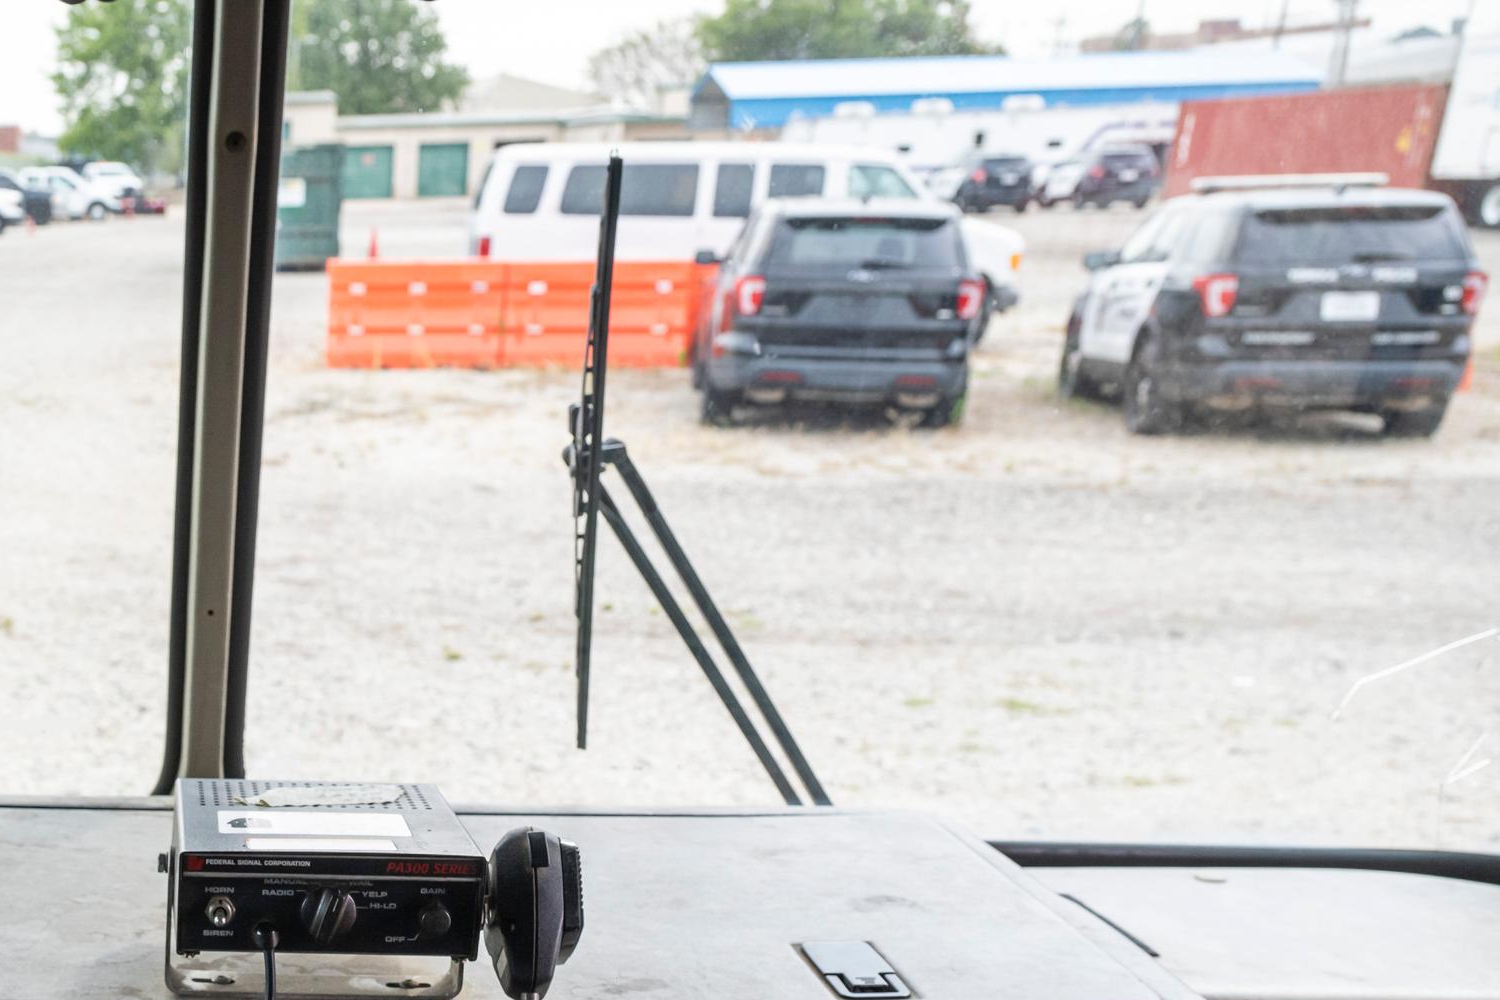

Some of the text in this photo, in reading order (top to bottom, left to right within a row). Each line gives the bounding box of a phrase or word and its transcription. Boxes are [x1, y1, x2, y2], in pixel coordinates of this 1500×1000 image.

[205, 858, 311, 868] FEDERAL SIGNAL CORPORATION
[386, 861, 477, 875] PA300 SERIES
[204, 886, 235, 894] HORN
[261, 889, 295, 897] RADIO
[420, 887, 446, 895] GAIN
[361, 890, 388, 899] YELP
[369, 902, 397, 910] HI-LO
[202, 929, 235, 937] SIREN
[384, 935, 407, 943] OFF
